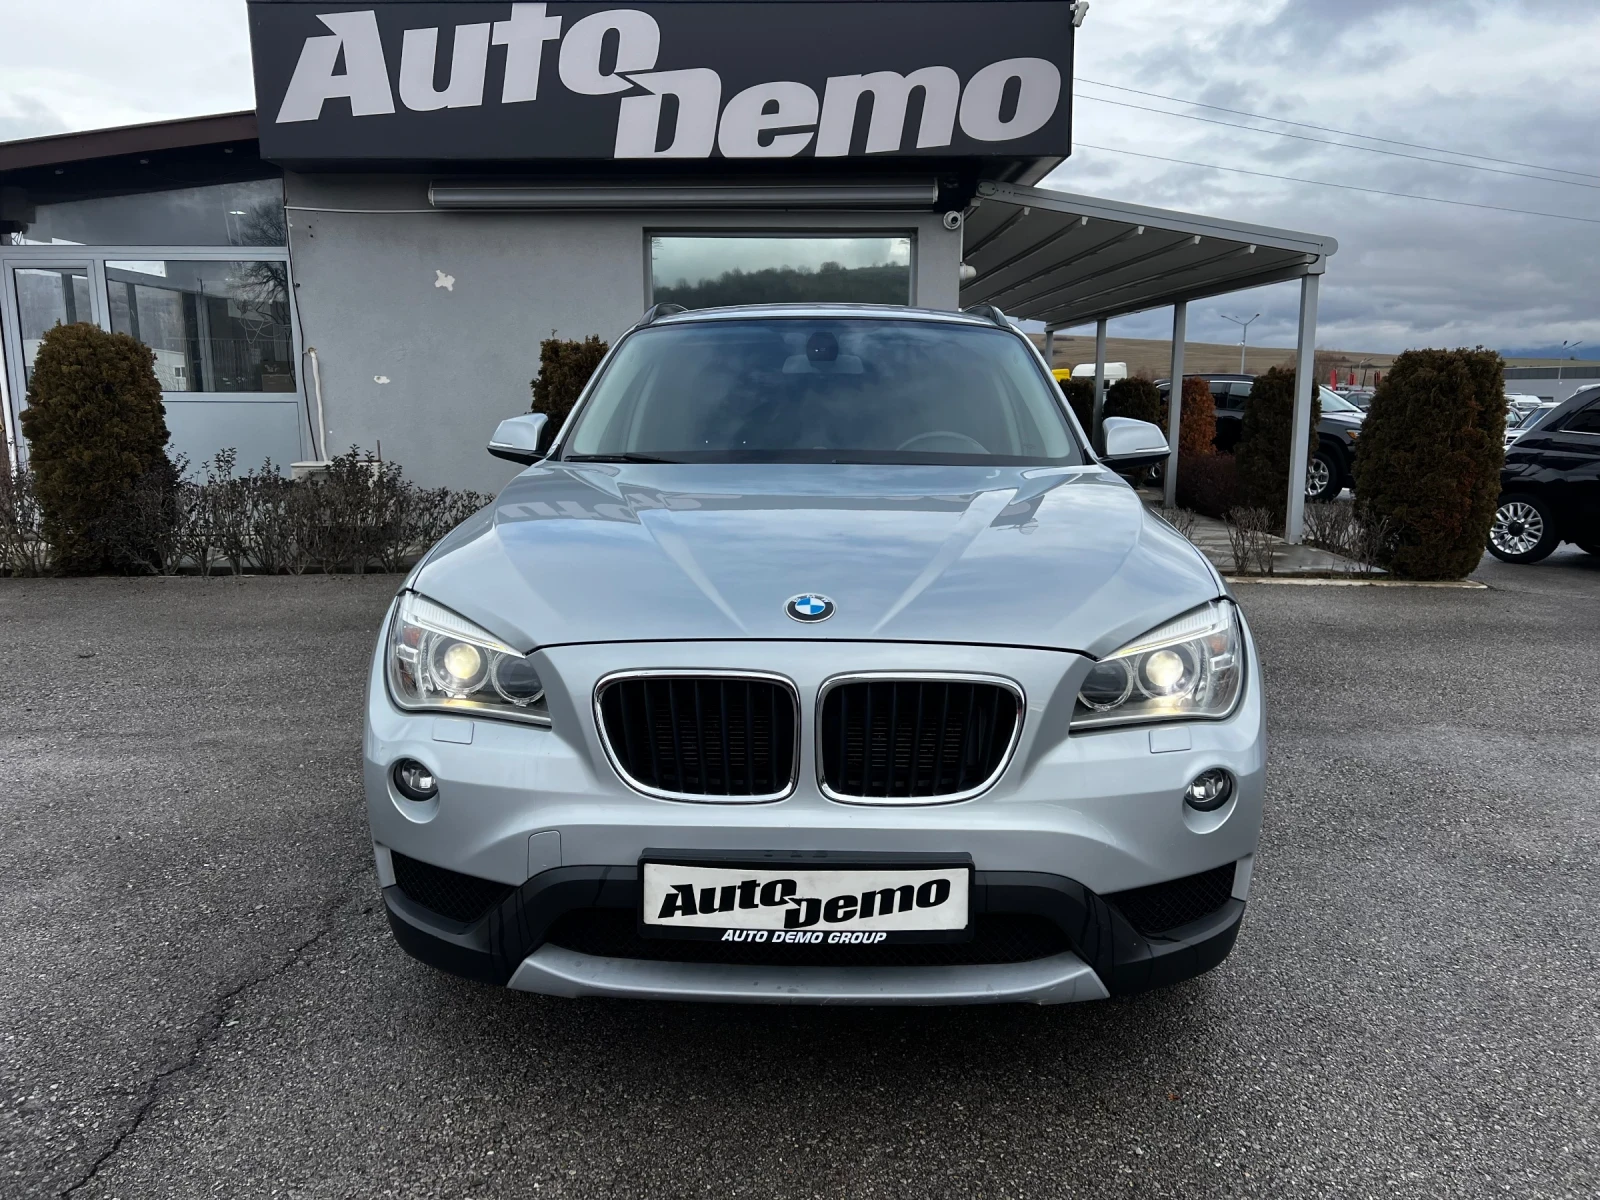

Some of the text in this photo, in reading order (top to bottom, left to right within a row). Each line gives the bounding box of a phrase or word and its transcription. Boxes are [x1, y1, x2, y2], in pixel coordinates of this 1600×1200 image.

[275, 2, 1061, 159] Auto Demo
[658, 878, 951, 929] Auto Demo
[721, 929, 887, 944] AUTO DEMO GROUP
